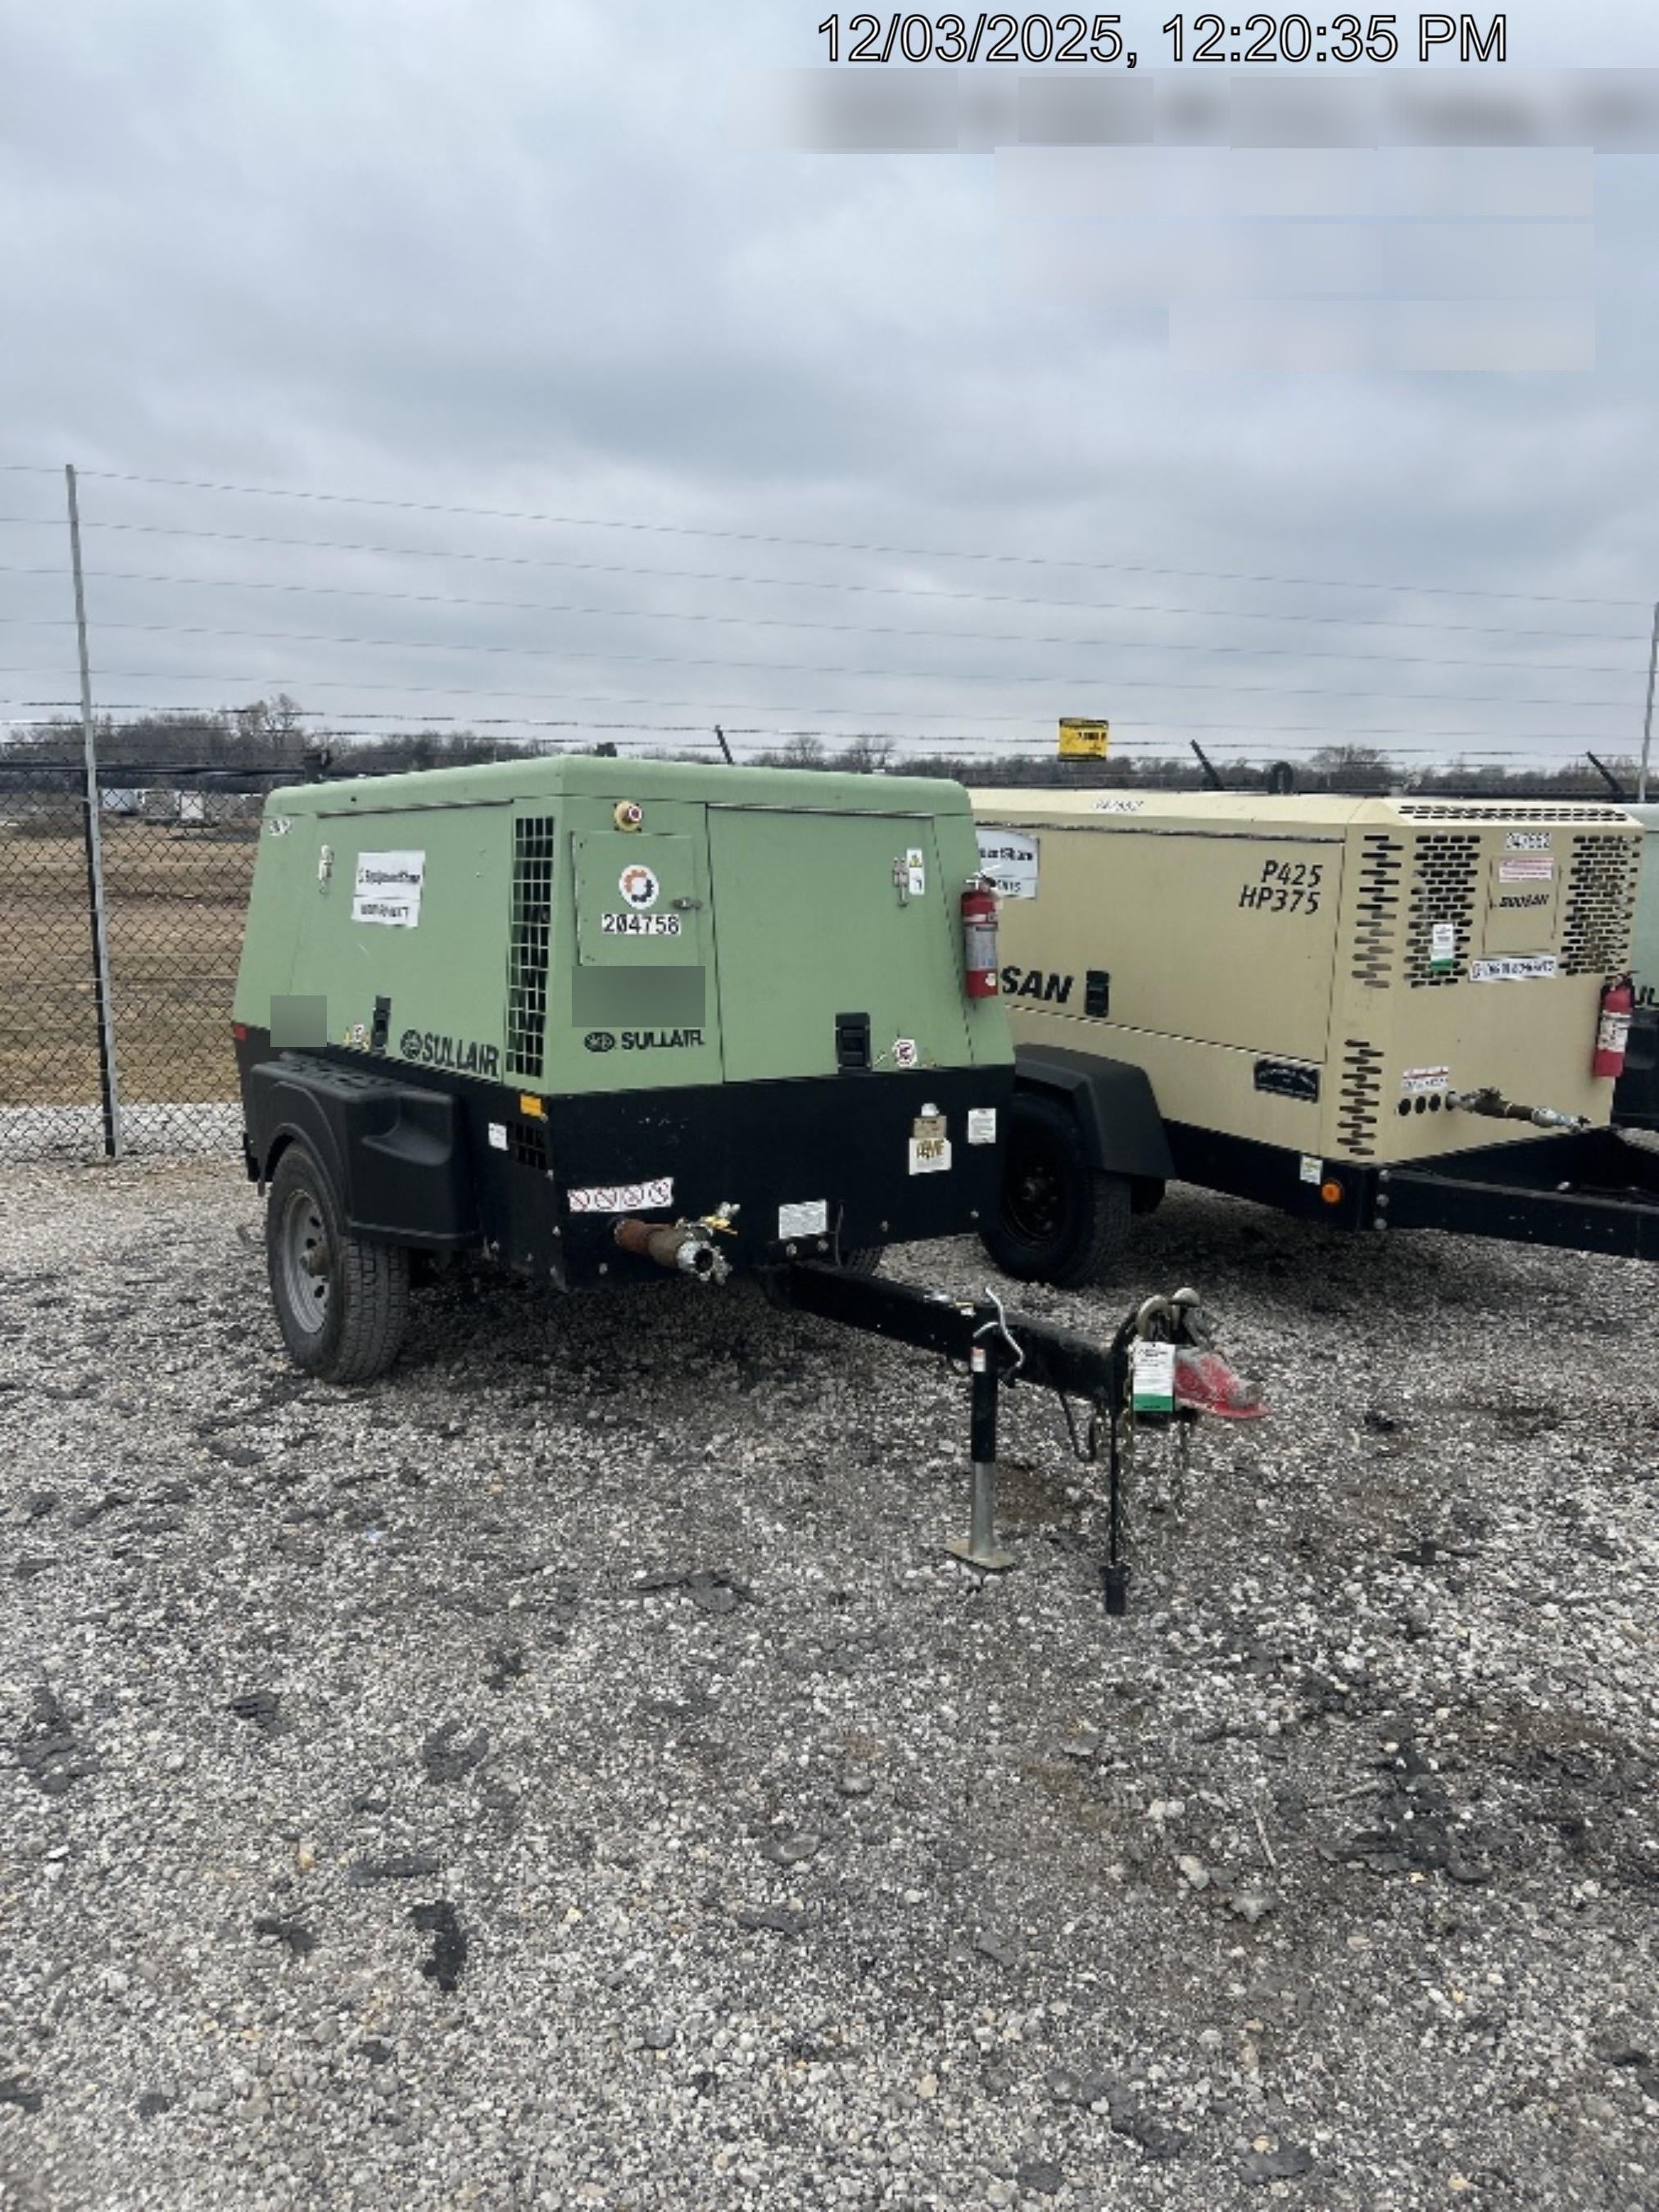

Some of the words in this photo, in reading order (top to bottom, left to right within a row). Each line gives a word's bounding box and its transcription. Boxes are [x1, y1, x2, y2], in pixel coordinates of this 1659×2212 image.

[1261, 860, 1323, 887] P425
[1239, 885, 1321, 915] HP375
[621, 1028, 705, 1050] SULLAIR
[422, 1031, 499, 1077] SULLAIR
